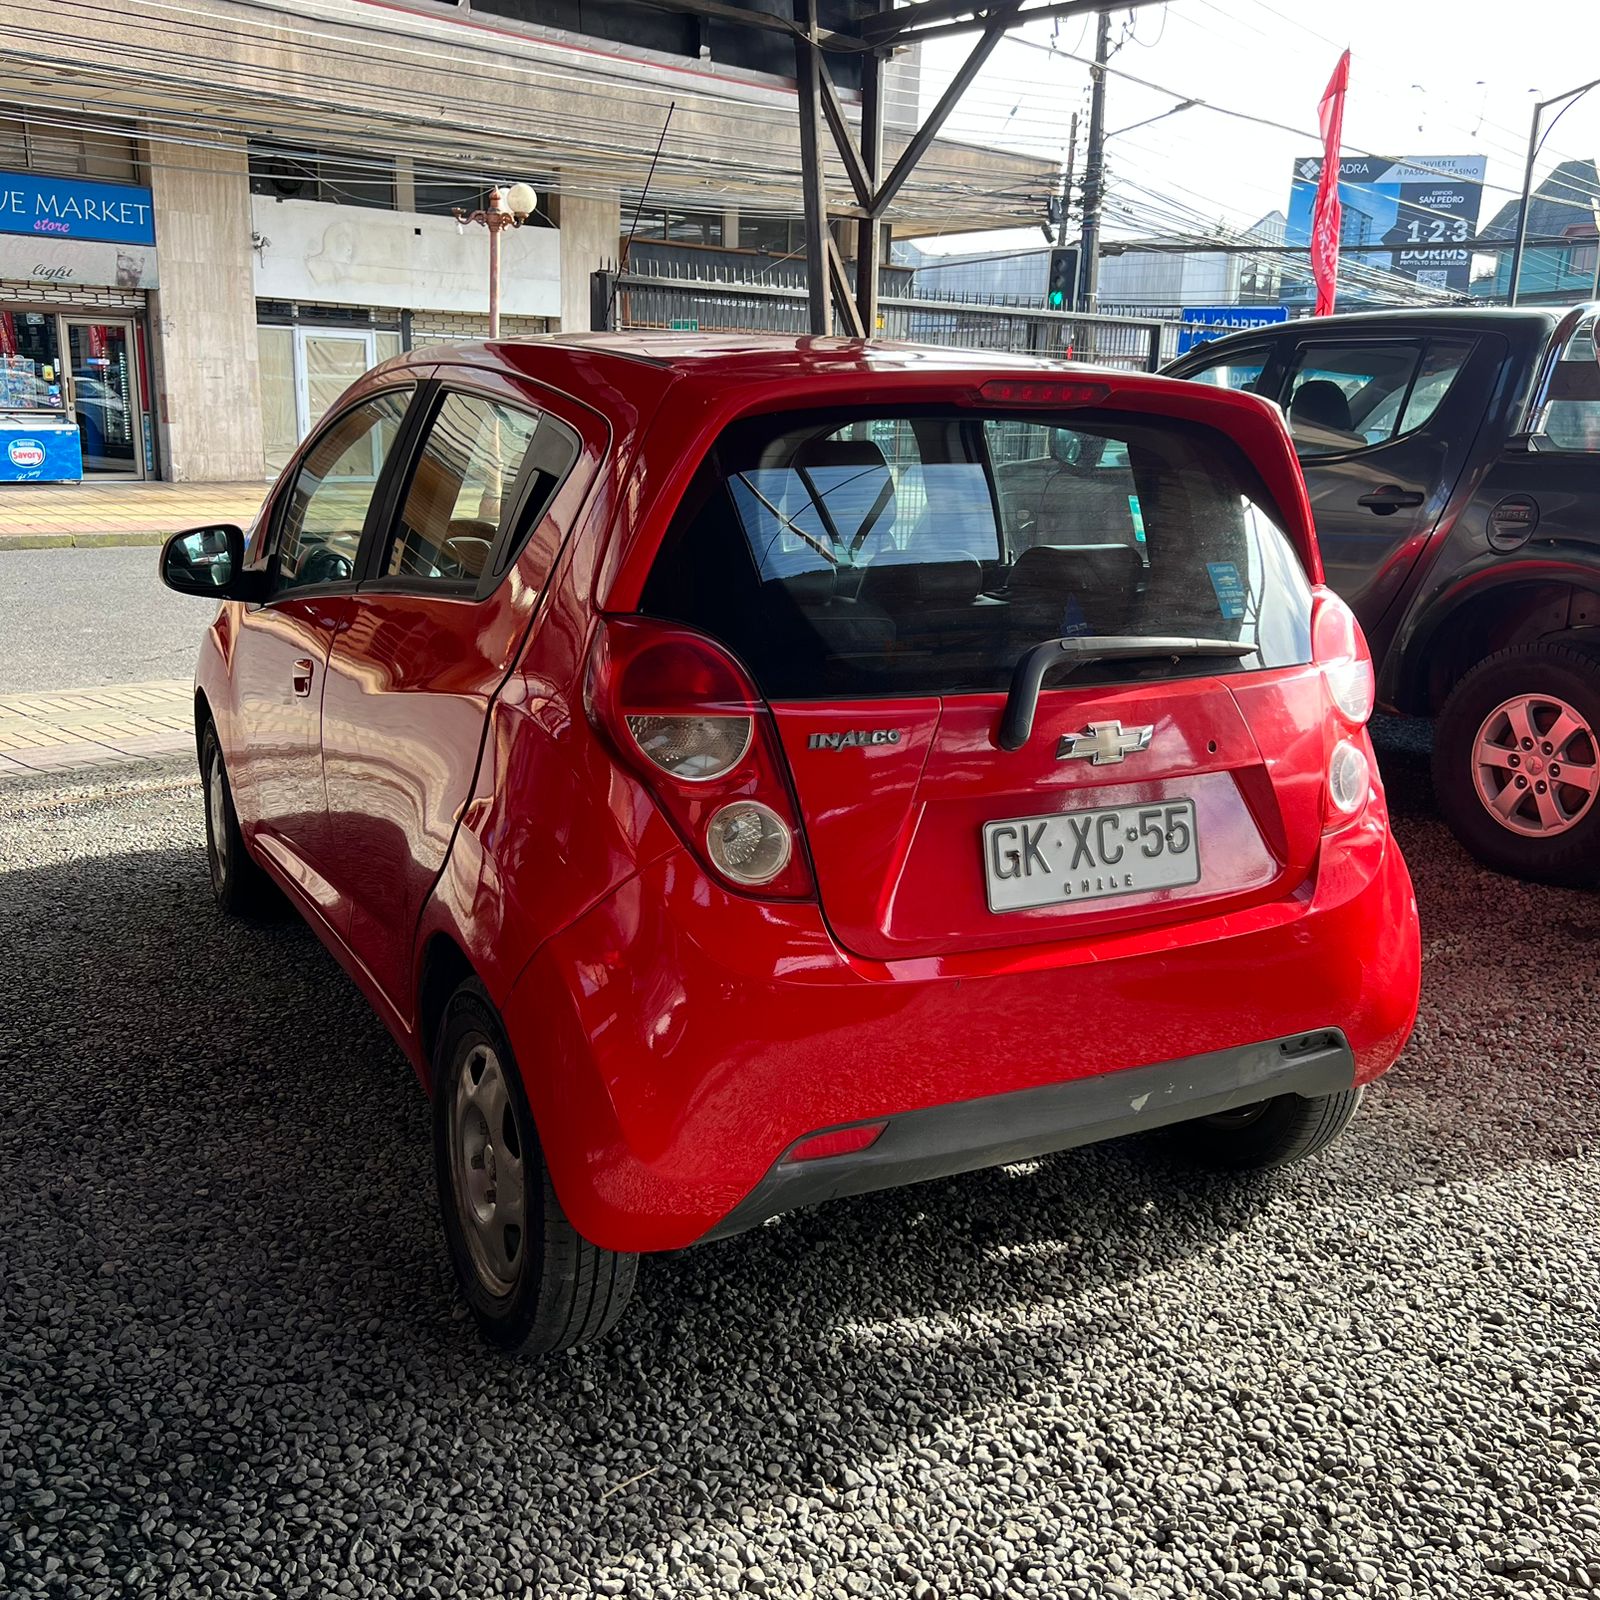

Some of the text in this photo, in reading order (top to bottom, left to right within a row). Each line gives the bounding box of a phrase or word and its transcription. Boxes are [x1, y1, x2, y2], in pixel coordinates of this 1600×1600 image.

[1334, 163, 1369, 174] ADRA
[35, 193, 150, 225] MARKET
[33, 218, 70, 233] store
[32, 263, 73, 280] light
[13, 450, 41, 460] Savory
[808, 729, 900, 752] INALCO
[1063, 874, 1134, 895] CHILE
